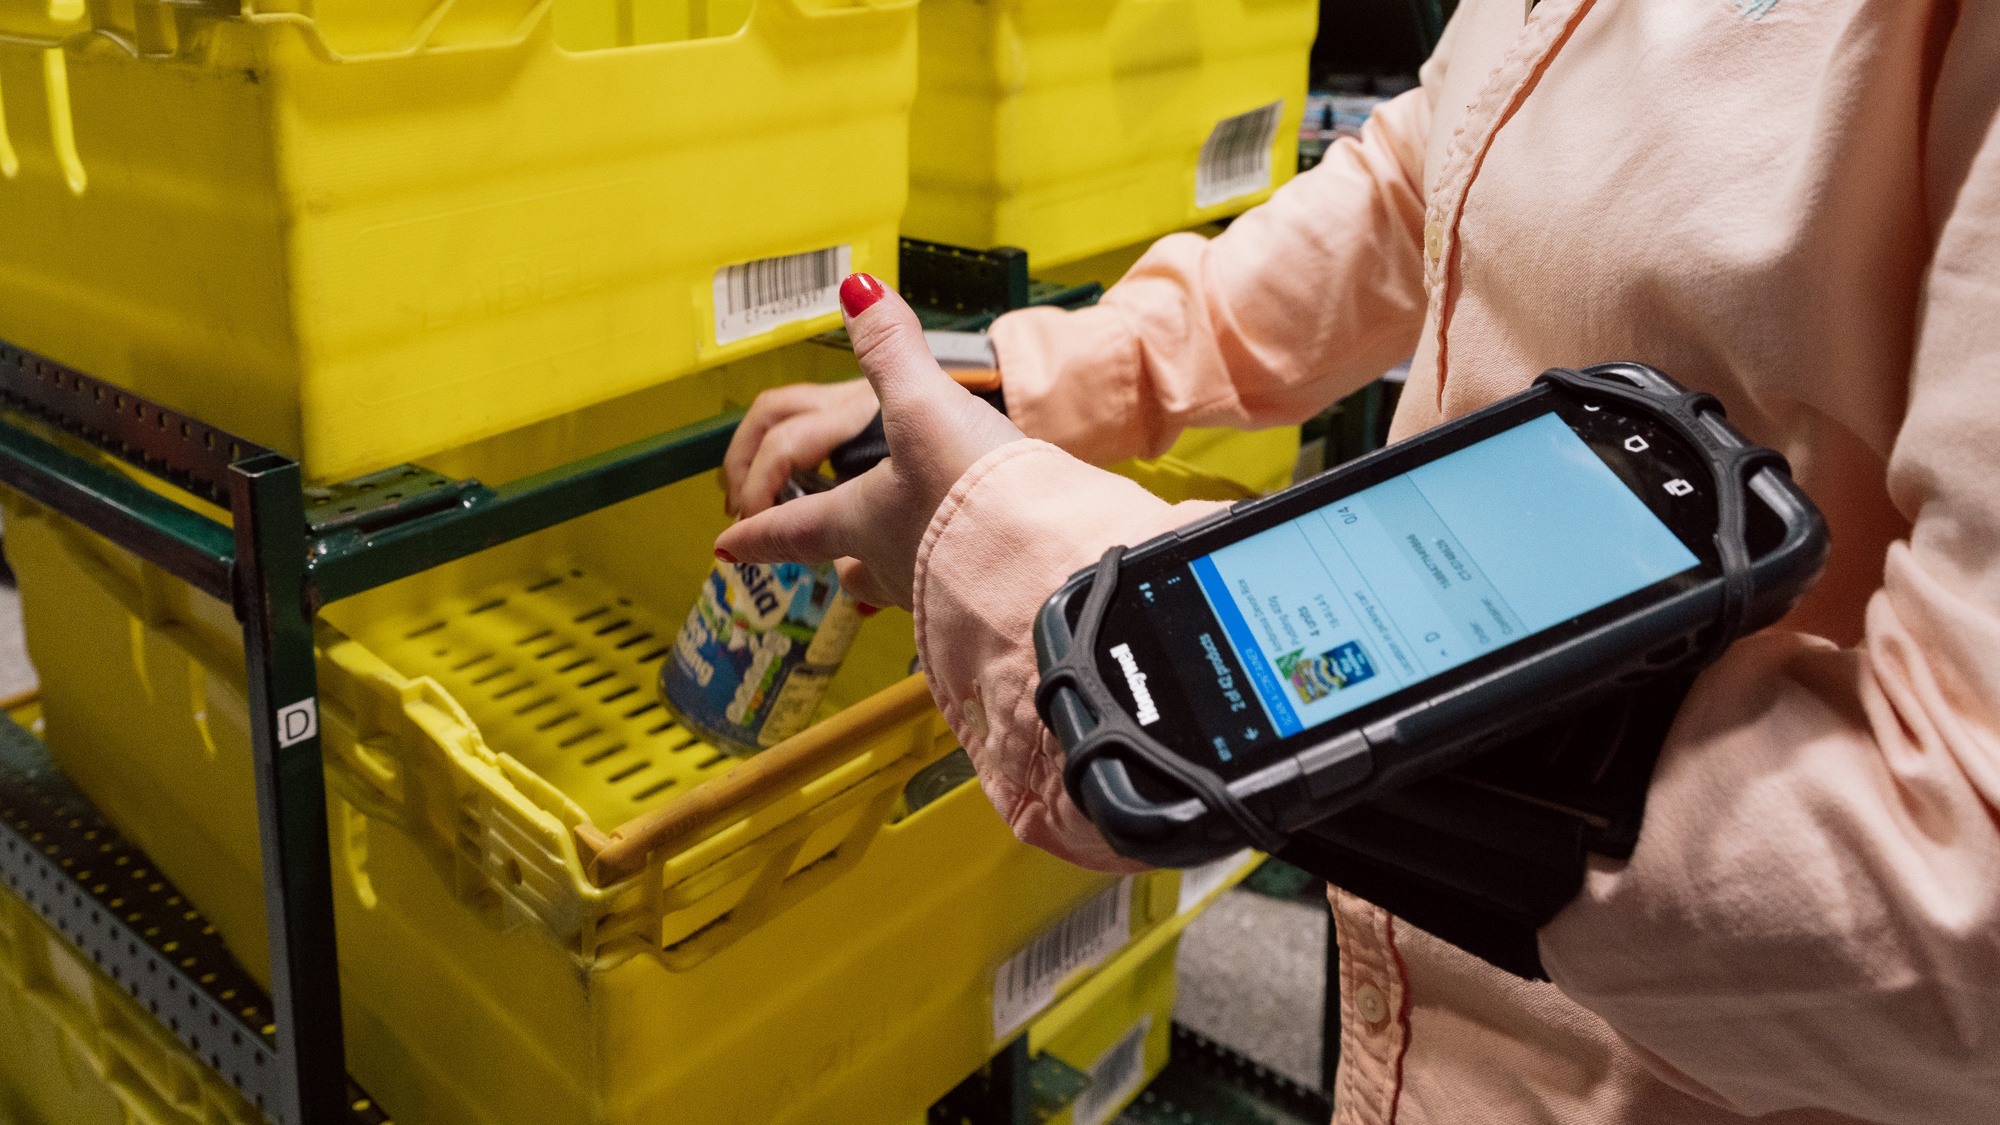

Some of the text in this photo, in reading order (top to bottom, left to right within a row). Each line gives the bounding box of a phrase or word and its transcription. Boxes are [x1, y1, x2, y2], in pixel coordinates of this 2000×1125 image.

[1336, 505, 1358, 524] 0/4
[1237, 578, 1250, 595] Rice
[1246, 594, 1264, 618] Devon
[1267, 594, 1282, 614] 400g
[1297, 605, 1317, 629] units
[1278, 613, 1300, 646] Pudding
[1353, 590, 1415, 676] Location in picking cart
[1423, 631, 1440, 643] D
[1198, 632, 1246, 712] 2 of 42 products
[1244, 647, 1275, 693] CONTAINER
[1109, 642, 1161, 727] Honeywell
[285, 708, 309, 740] D
